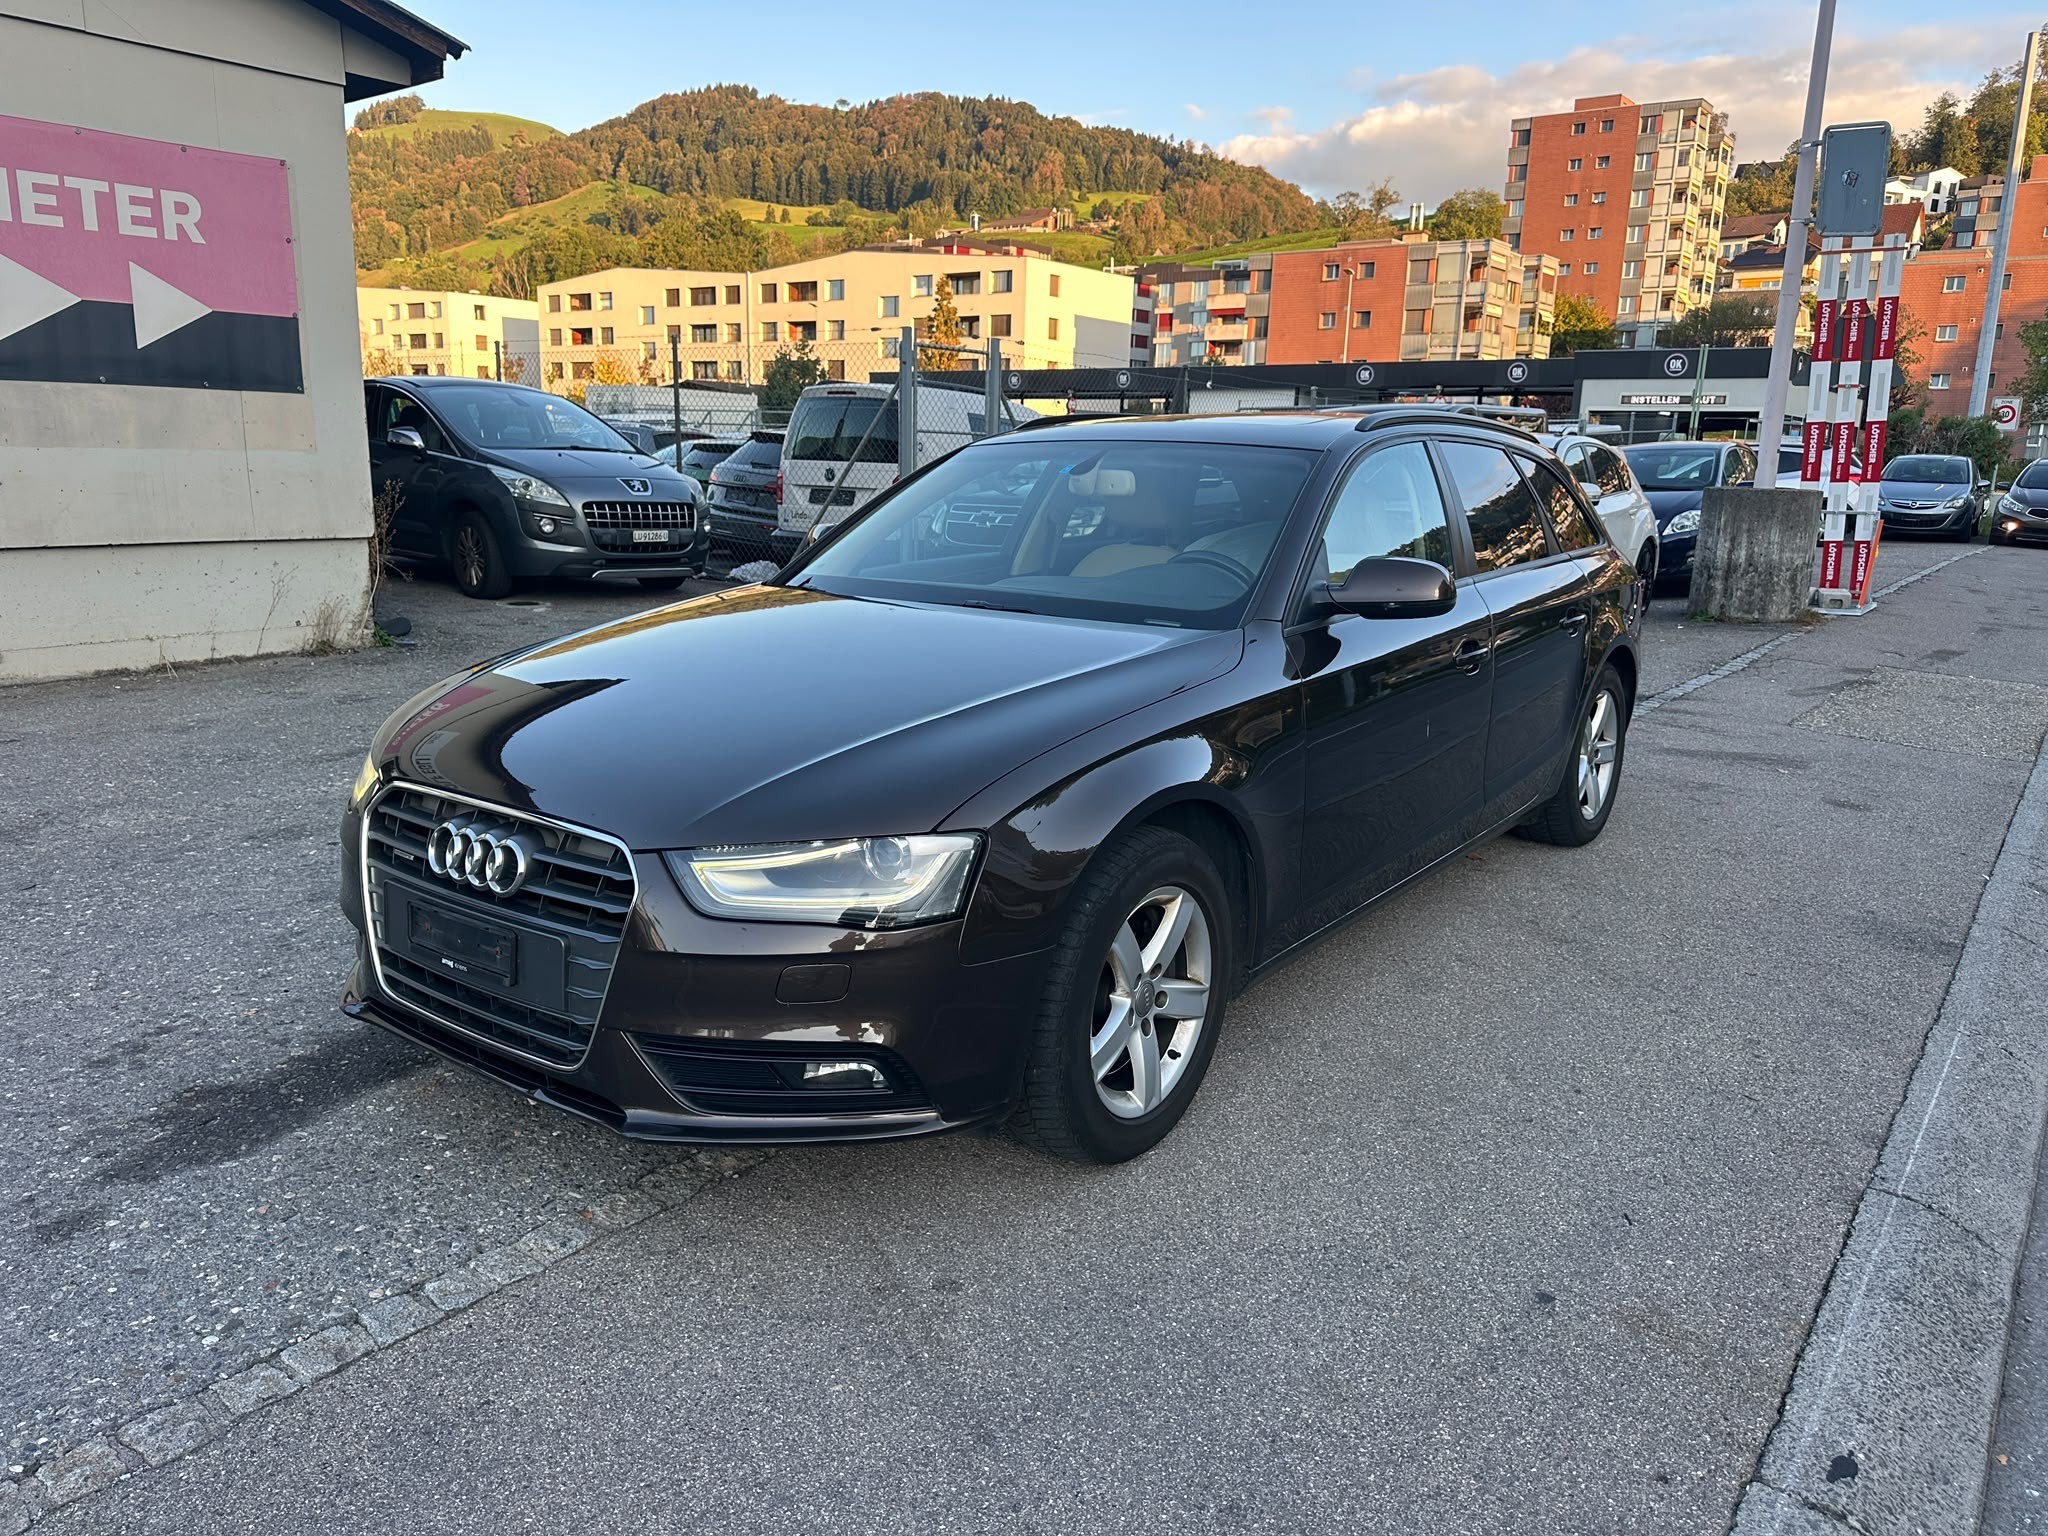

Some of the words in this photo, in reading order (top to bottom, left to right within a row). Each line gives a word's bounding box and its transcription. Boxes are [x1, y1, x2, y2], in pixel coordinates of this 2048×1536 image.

[1819, 302, 1831, 343] LÖTSCHER
[1881, 299, 1893, 341] LÖTSCHER
[1670, 359, 1683, 369] OK
[1807, 424, 1819, 463] LÖTSCHER
[1837, 424, 1848, 464] LÖTSCHER
[1869, 424, 1880, 464] LÖTSCHER
[1826, 543, 1837, 581] LÖTSCHER
[1857, 543, 1867, 582] LÖTSCHER
